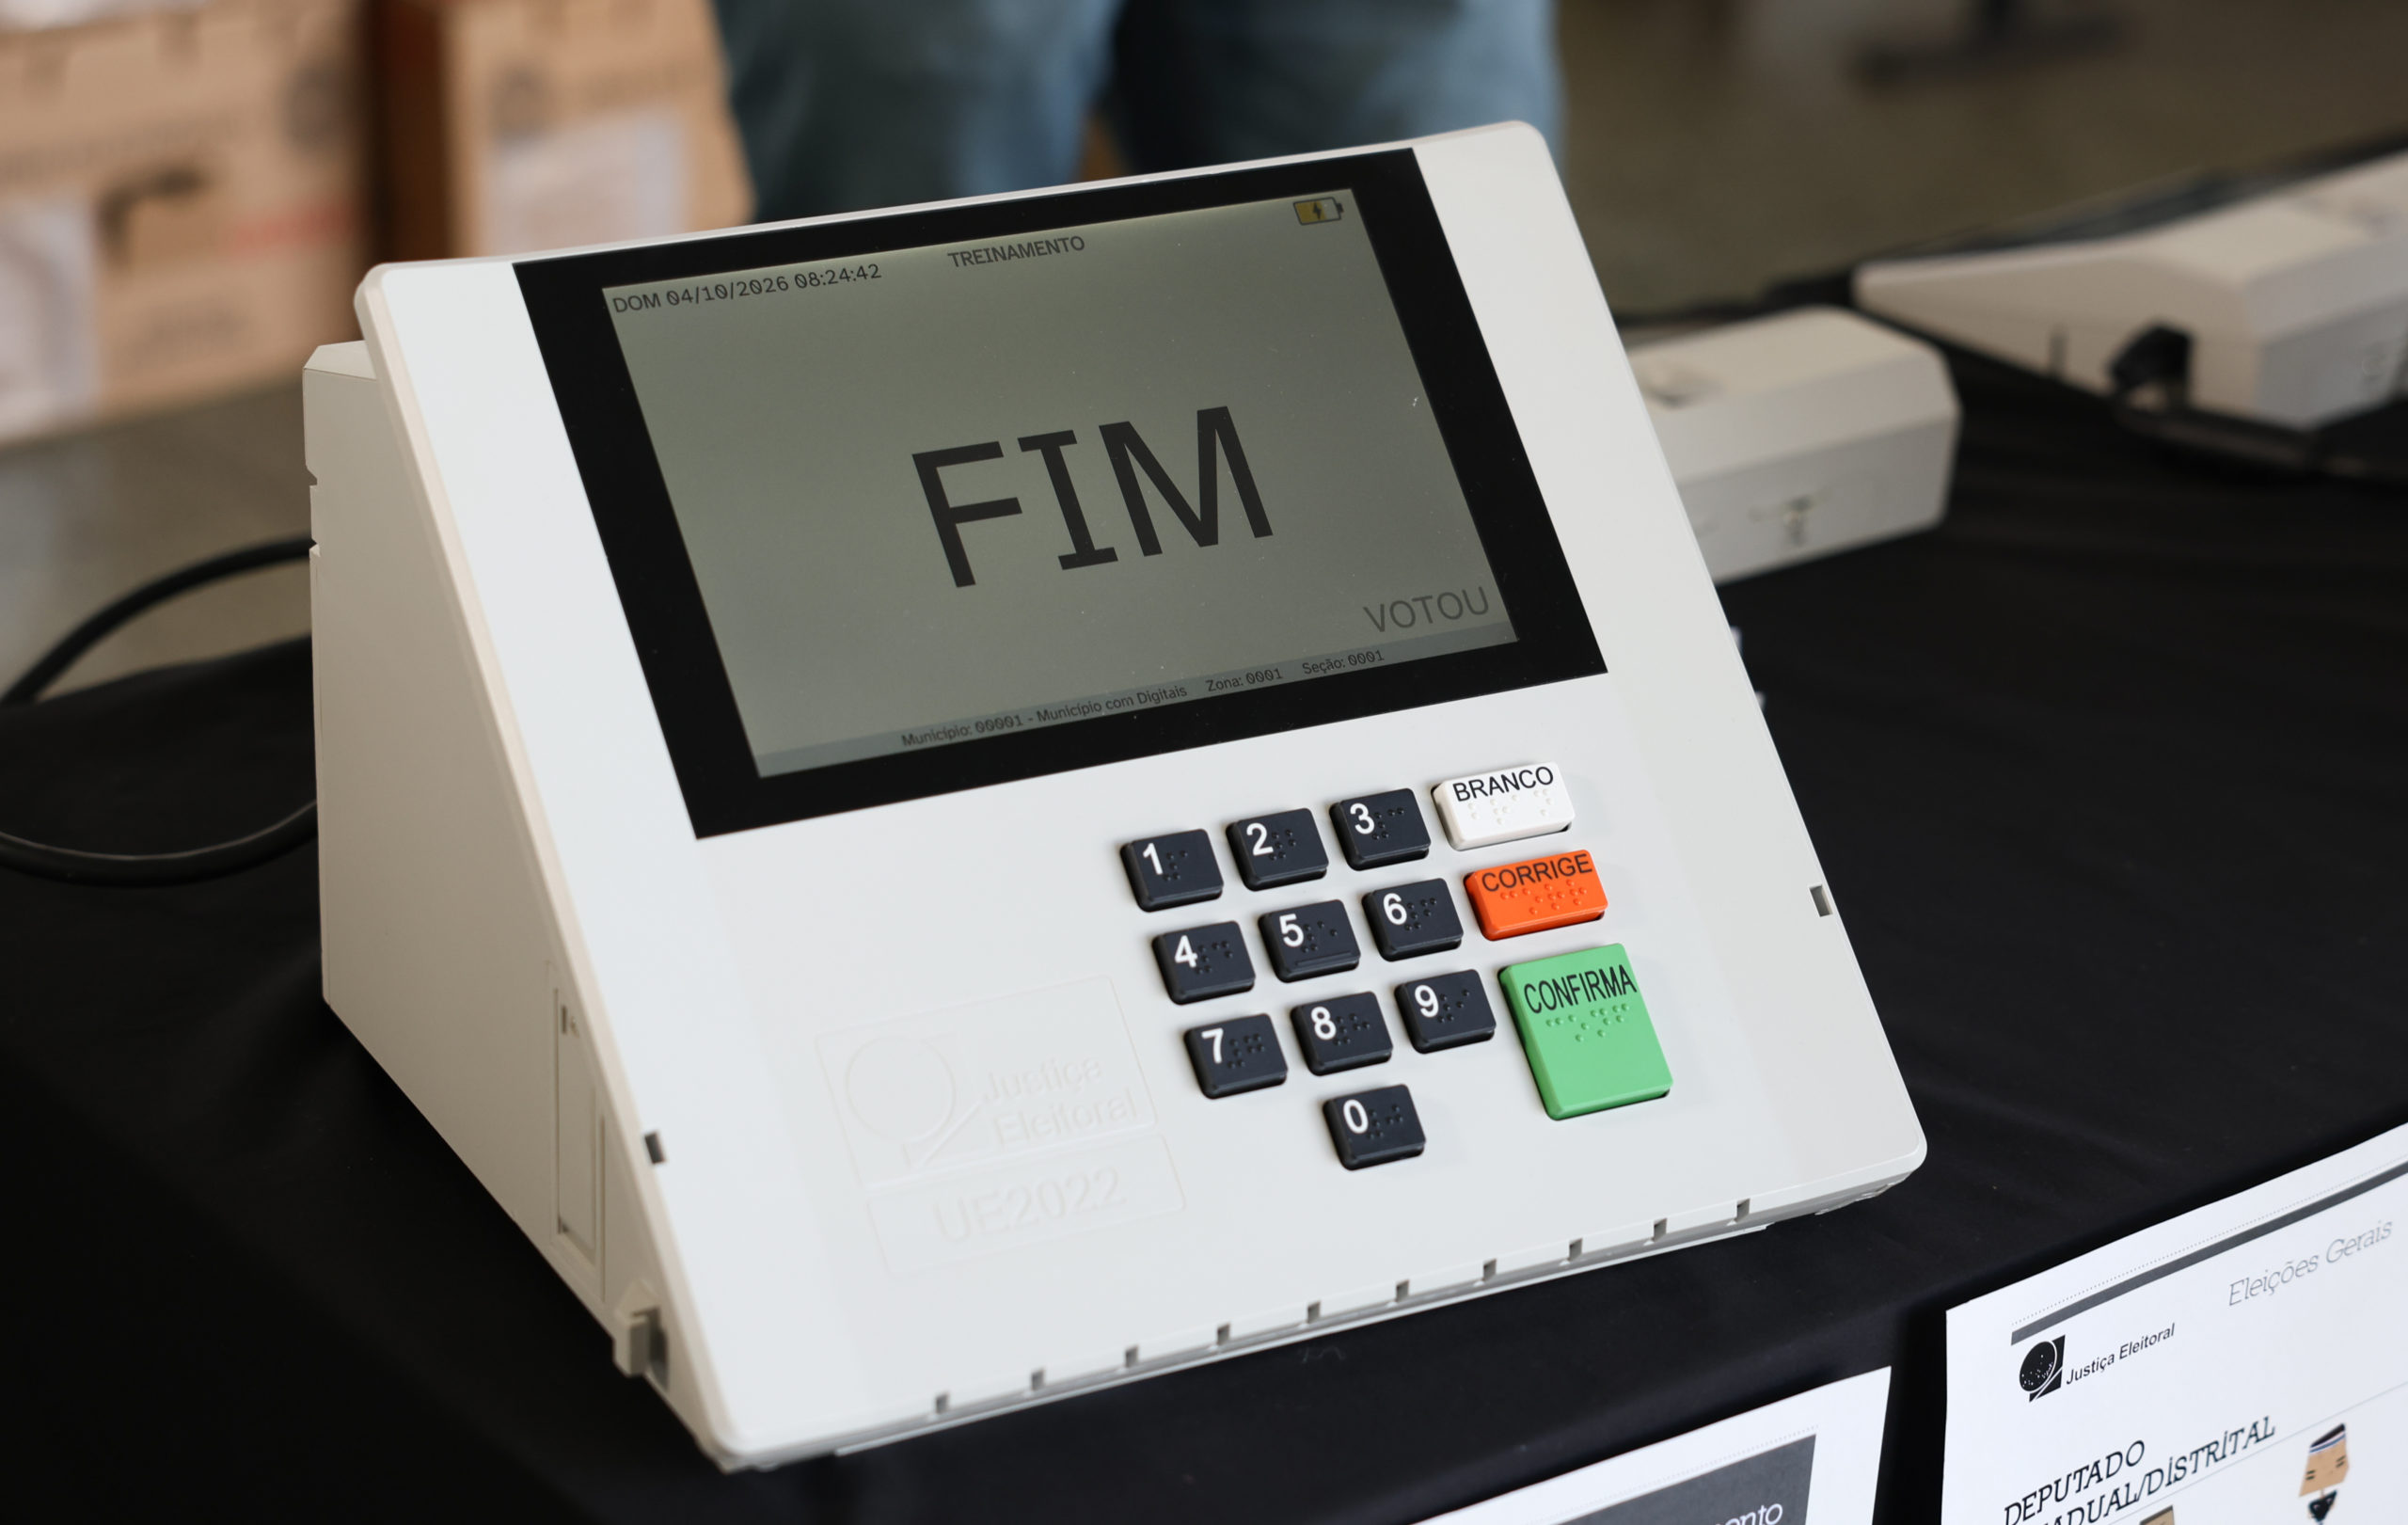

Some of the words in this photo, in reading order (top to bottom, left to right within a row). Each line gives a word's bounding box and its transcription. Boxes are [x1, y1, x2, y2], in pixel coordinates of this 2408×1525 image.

[947, 235, 1085, 268] TREINAMENTO
[613, 293, 661, 313] DOM
[666, 276, 789, 306] 04/10/2026
[794, 263, 881, 289] 08:24:42
[912, 406, 1274, 588] FIM
[1363, 586, 1490, 632] VOTOU
[900, 723, 973, 747] Município:
[974, 715, 1023, 733] 00001
[1037, 702, 1102, 724] Município
[1105, 695, 1134, 710] com
[1136, 685, 1188, 706] Digitais
[1205, 677, 1244, 692] Zona:
[1245, 668, 1284, 685] 0001
[1302, 660, 1346, 675] Seção:
[1347, 650, 1385, 666] 0001
[1452, 766, 1554, 802] BRANCO
[1350, 802, 1375, 834] 3
[1245, 822, 1274, 856] 2
[1142, 842, 1164, 875] 1
[1481, 853, 1593, 892] CORRIGE
[1383, 893, 1407, 926] 6
[1278, 913, 1305, 947] 5
[1174, 935, 1198, 968] 4
[1414, 984, 1439, 1018] 9
[1523, 963, 1638, 1014] CONFIRMA
[1310, 1006, 1337, 1040] 8
[1200, 1028, 1224, 1064] 7
[982, 1056, 1103, 1103] Justiça
[993, 1086, 1138, 1147] Eleitoral
[1342, 1099, 1369, 1134] 0
[933, 1165, 1127, 1245] UE2022
[2227, 1254, 2320, 1307] Eleições
[2325, 1220, 2393, 1263] Gerais
[2066, 1353, 2115, 1385] Justiça
[2118, 1322, 2176, 1360] Eleitoral
[2004, 1439, 2146, 1525] DEPUTADO
